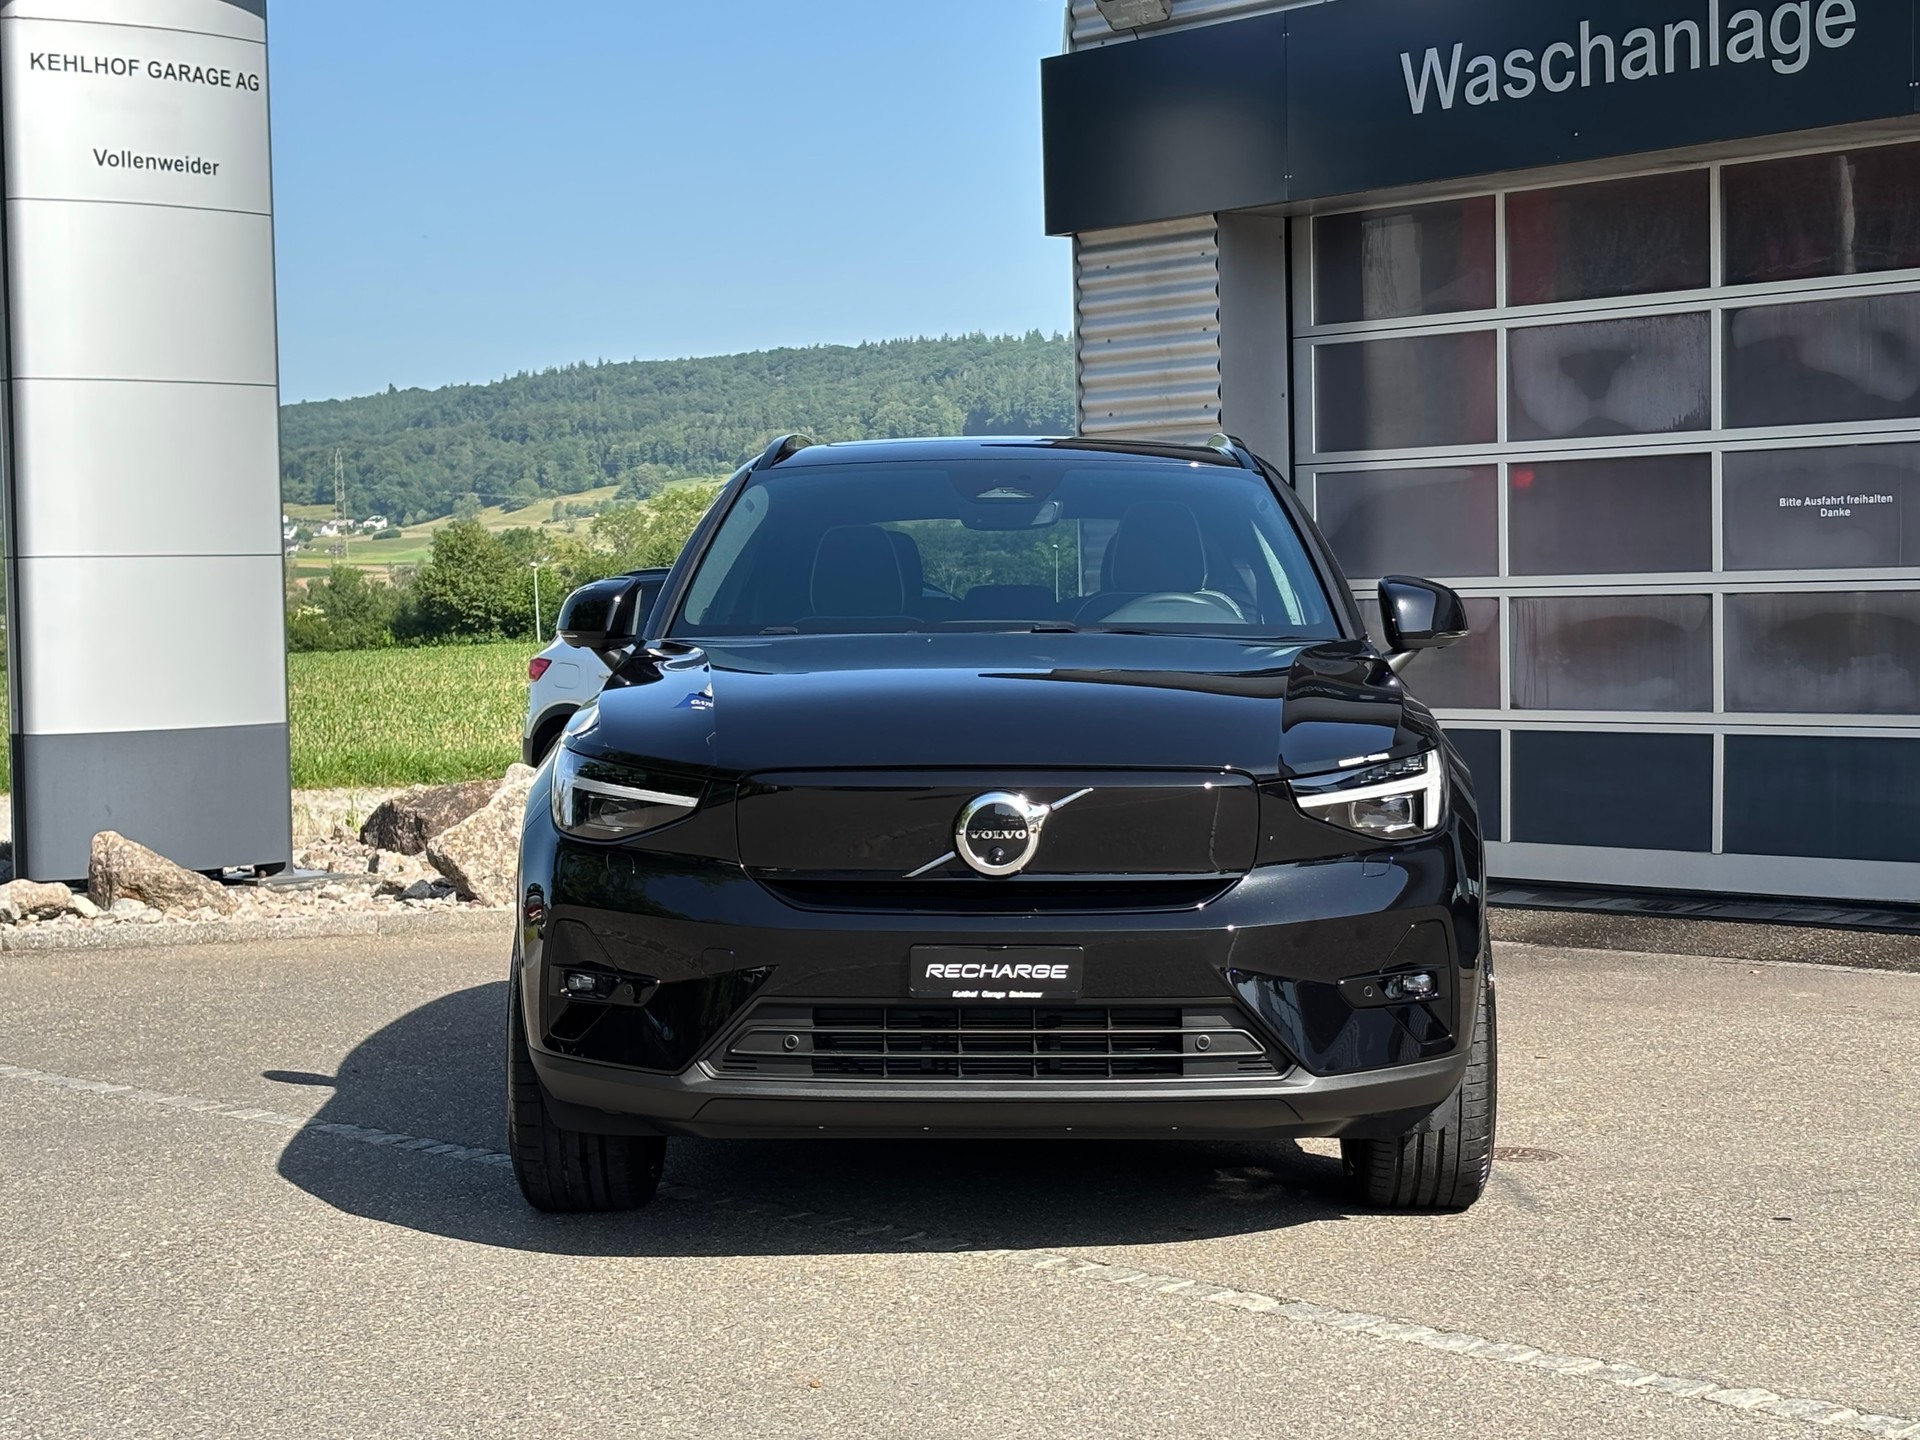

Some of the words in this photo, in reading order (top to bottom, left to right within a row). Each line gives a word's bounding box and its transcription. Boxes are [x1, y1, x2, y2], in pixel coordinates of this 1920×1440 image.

[1400, 0, 1857, 115] Waschanlage
[30, 52, 141, 77] KEHLHOF
[147, 61, 232, 88] GARAGE
[235, 72, 260, 92] AG
[93, 148, 219, 175] Vollenweider
[1779, 497, 1802, 507] Bitte
[1804, 495, 1845, 506] Ausfahrt
[1846, 494, 1893, 504] freihalten
[1820, 507, 1851, 517] Danke
[968, 830, 1027, 839] VOLVO
[925, 963, 1069, 979] RECHARGE
